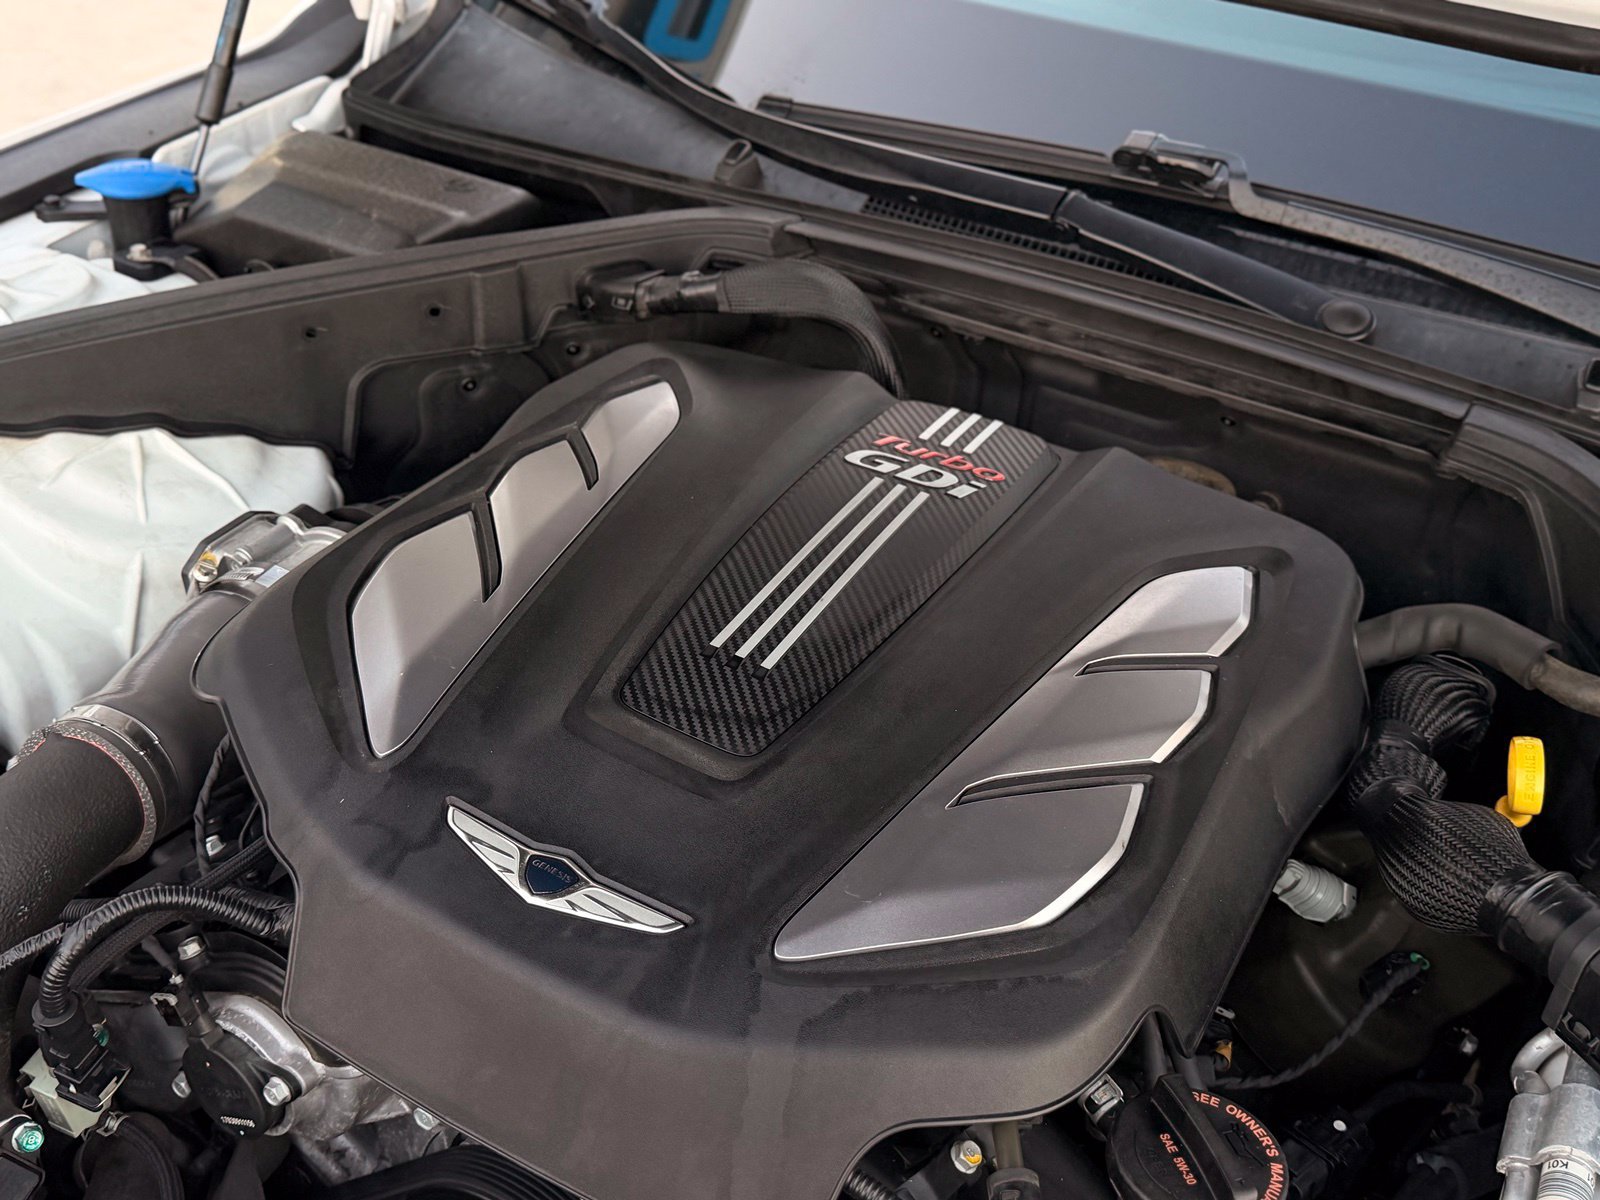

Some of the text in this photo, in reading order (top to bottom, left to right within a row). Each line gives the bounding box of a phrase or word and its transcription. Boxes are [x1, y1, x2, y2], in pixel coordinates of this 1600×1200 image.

[532, 860, 572, 883] GENESIS
[1192, 1091, 1221, 1108] SEE
[1225, 1104, 1280, 1157] OWNER'S
[1160, 1133, 1198, 1185] SAE 5W-30
[1547, 1160, 1569, 1169] K01
